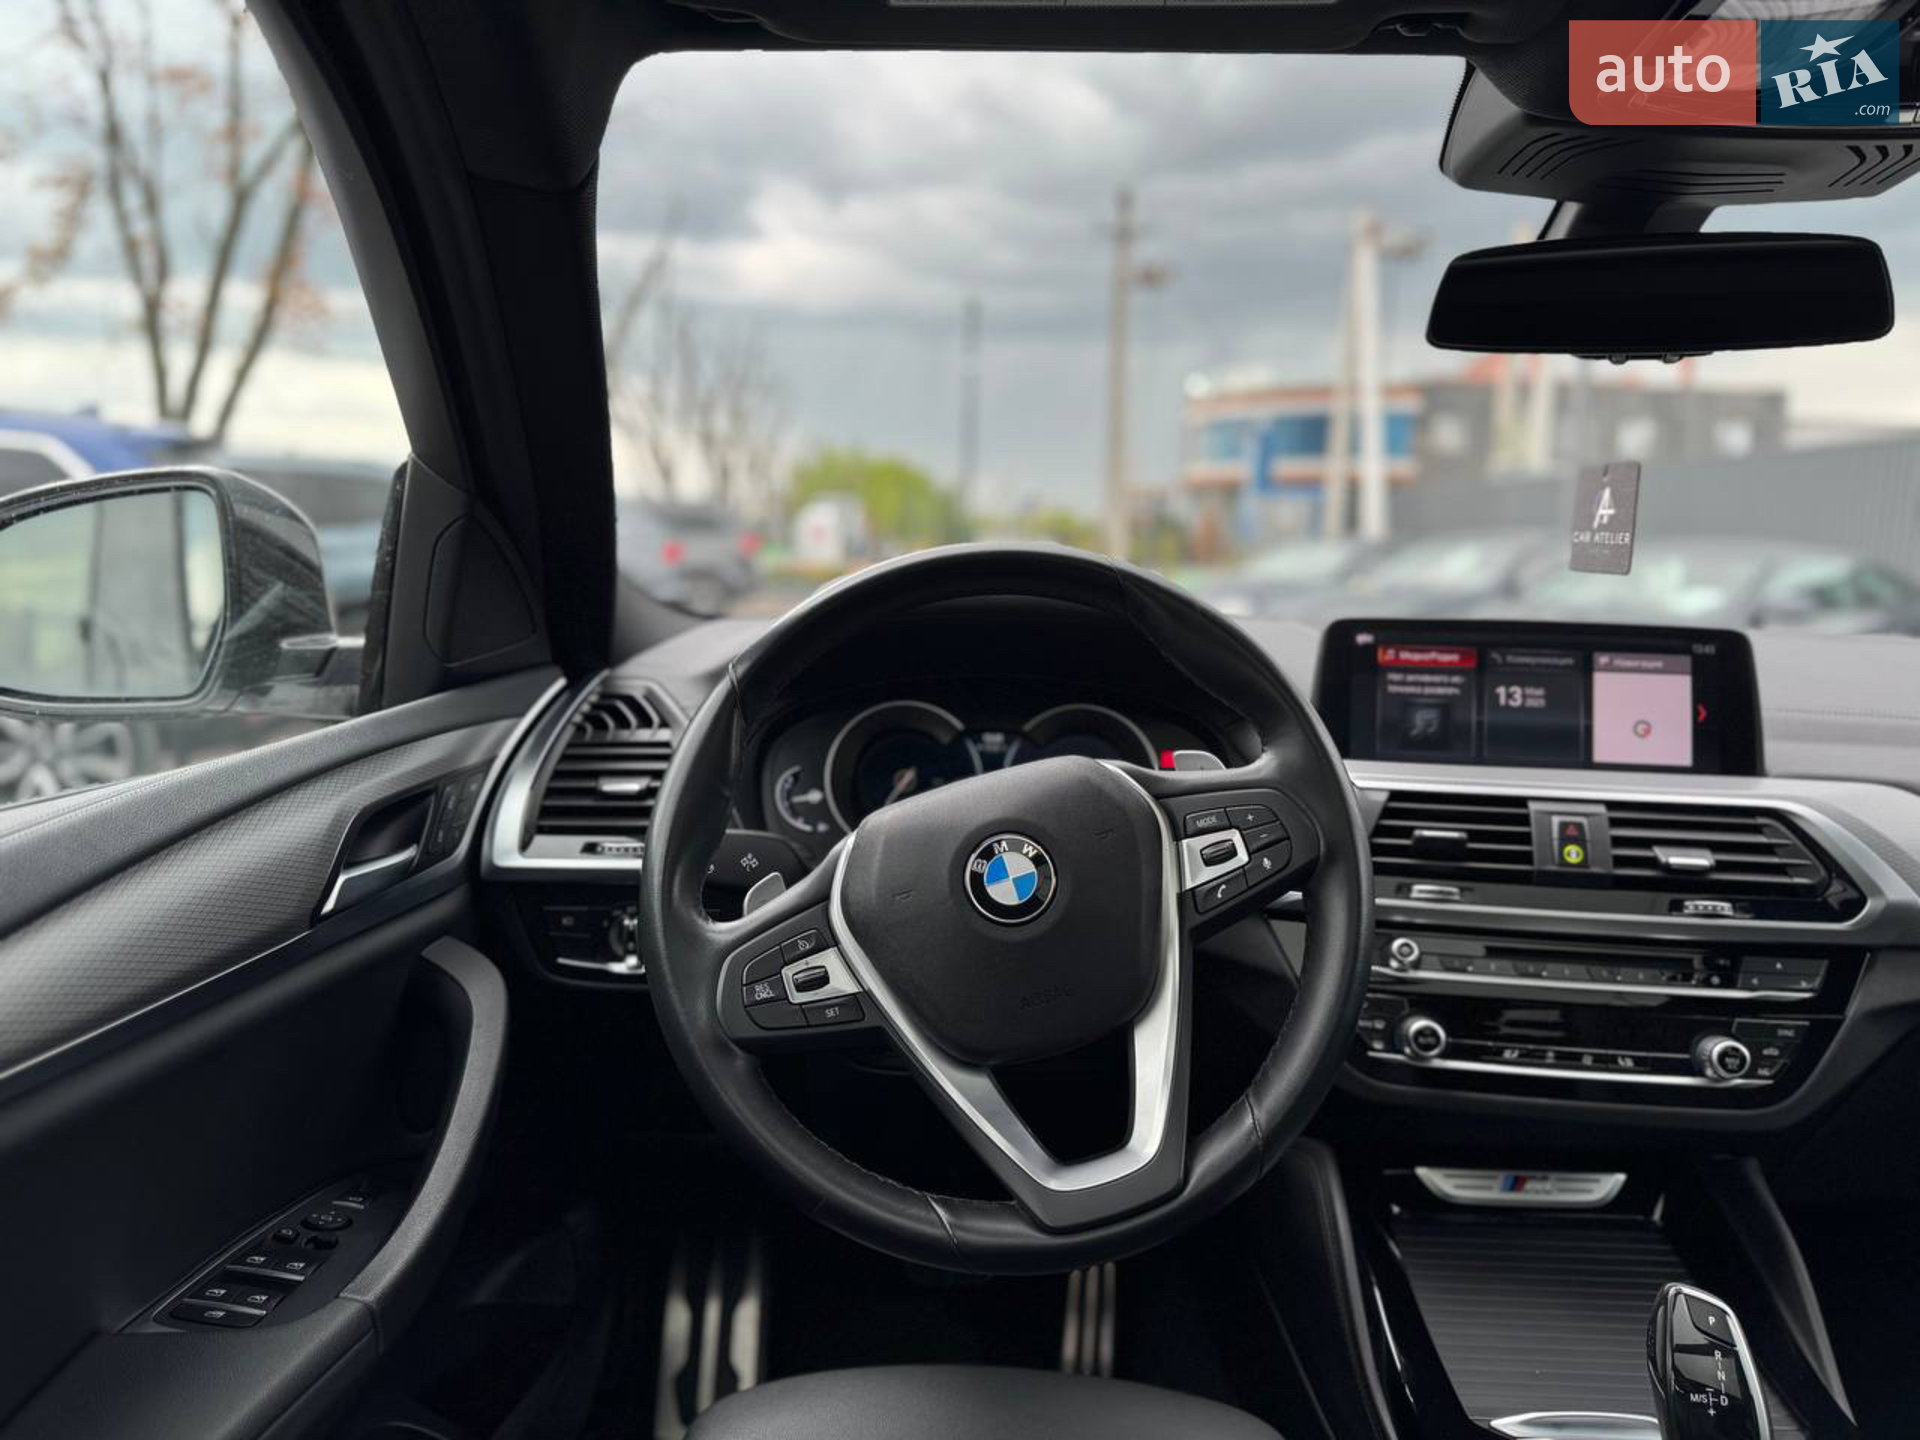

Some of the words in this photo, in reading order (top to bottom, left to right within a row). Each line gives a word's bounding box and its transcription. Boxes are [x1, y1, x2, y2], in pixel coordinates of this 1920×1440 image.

[1495, 685, 1523, 708] 13
[972, 840, 1037, 874] BMW
[825, 1006, 839, 1018] SET
[1708, 1316, 1715, 1326] P
[1714, 1350, 1722, 1361] R
[1717, 1370, 1726, 1381] N
[1720, 1395, 1729, 1406] D
